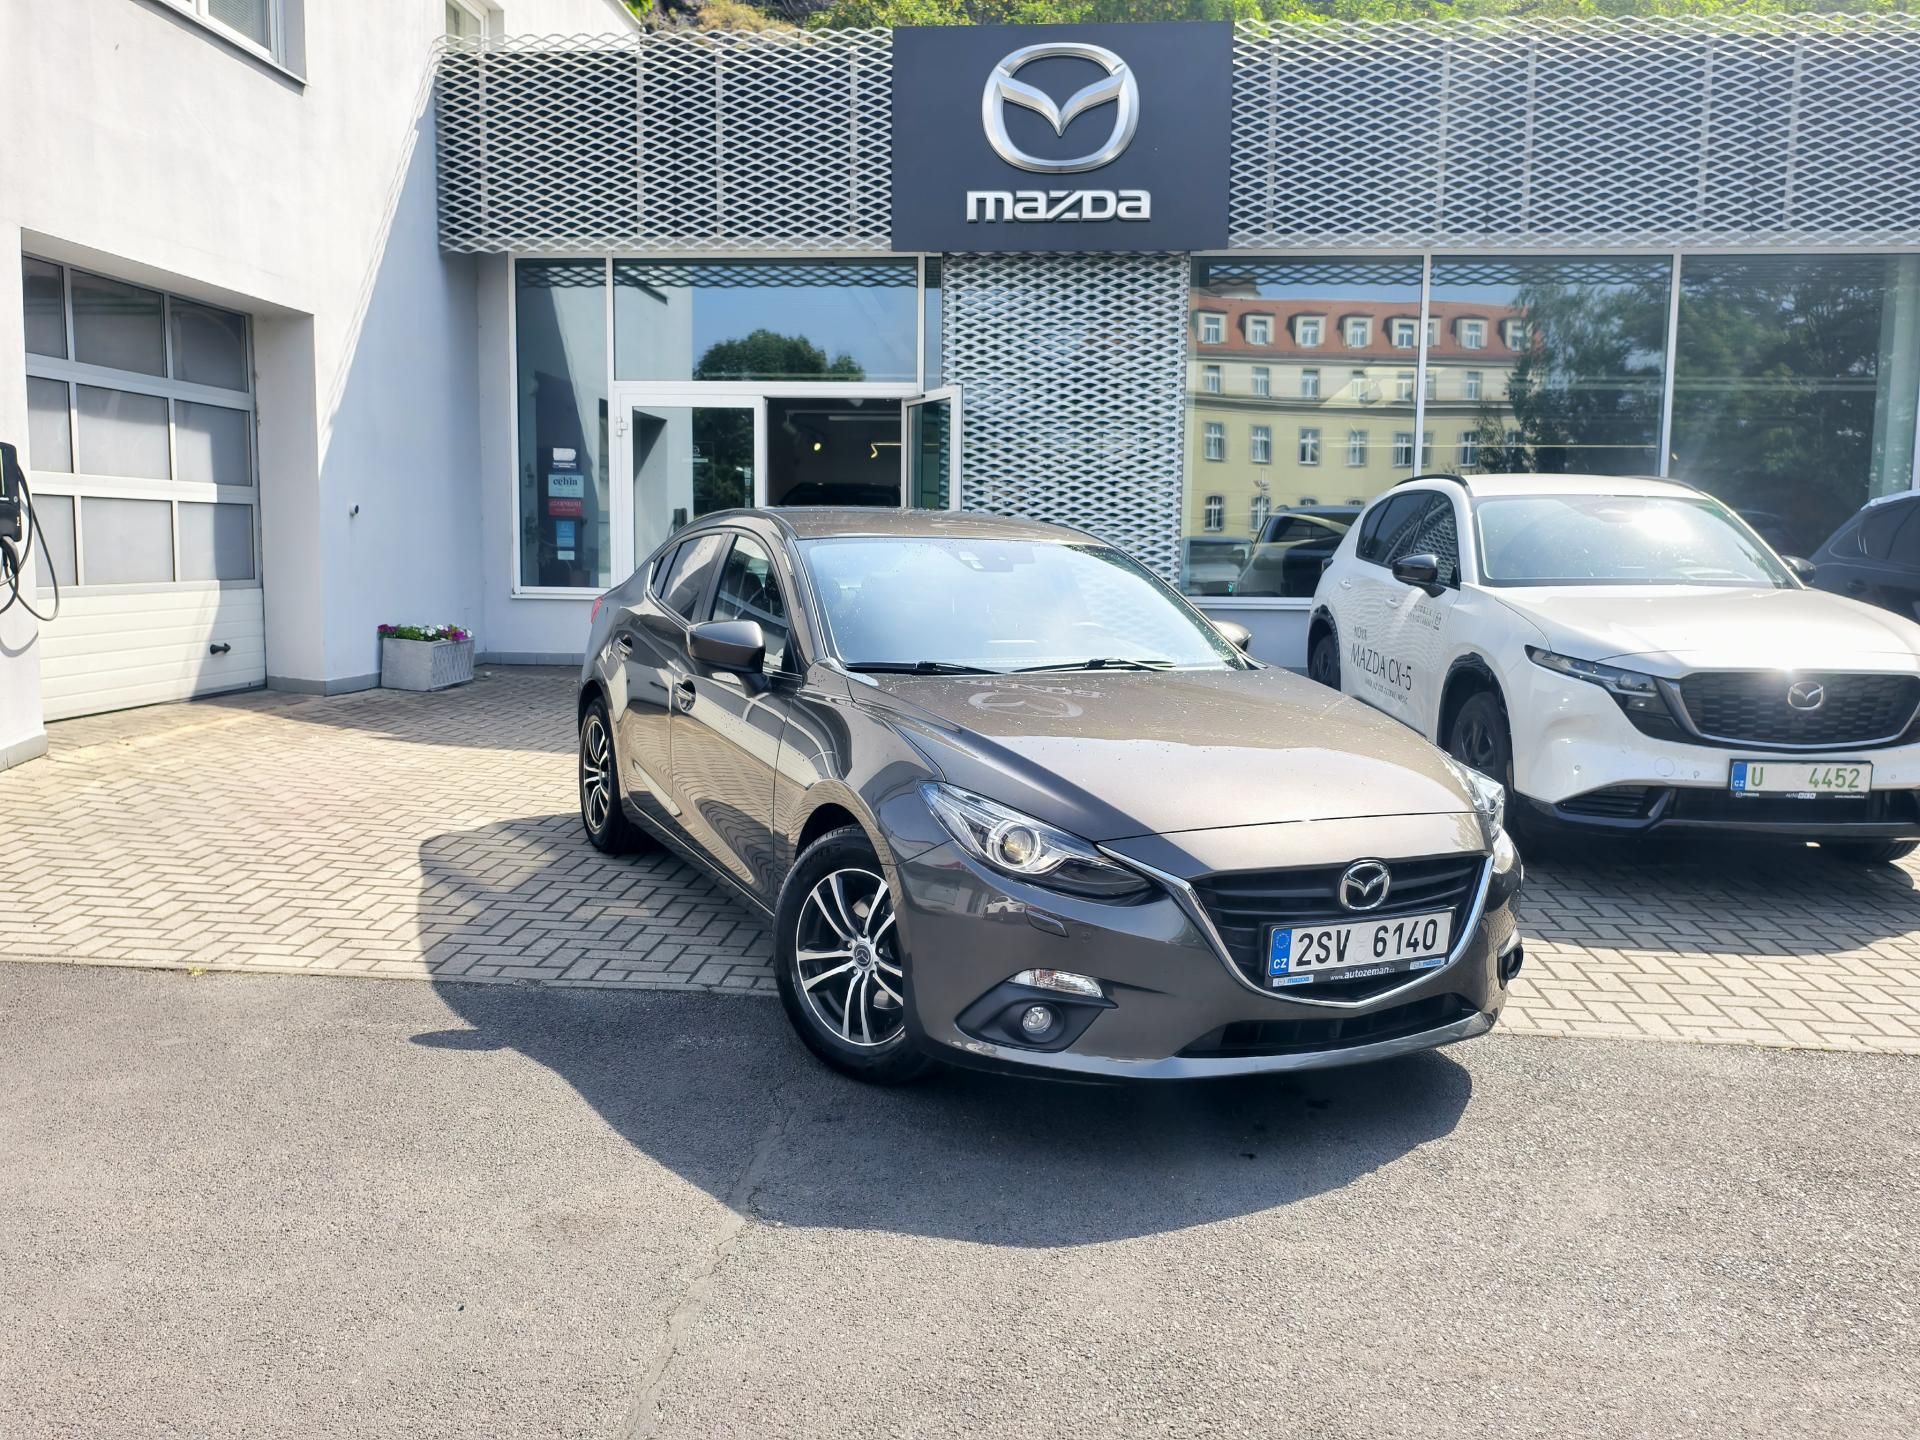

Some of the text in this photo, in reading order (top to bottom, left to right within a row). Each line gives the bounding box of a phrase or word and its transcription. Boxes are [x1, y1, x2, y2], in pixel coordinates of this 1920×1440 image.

[1350, 642, 1412, 691] MAZDA CX-5
[1751, 767, 1764, 787] U
[1808, 767, 1860, 789] 4452
[1273, 918, 1438, 970] CZ 2SV 6140
